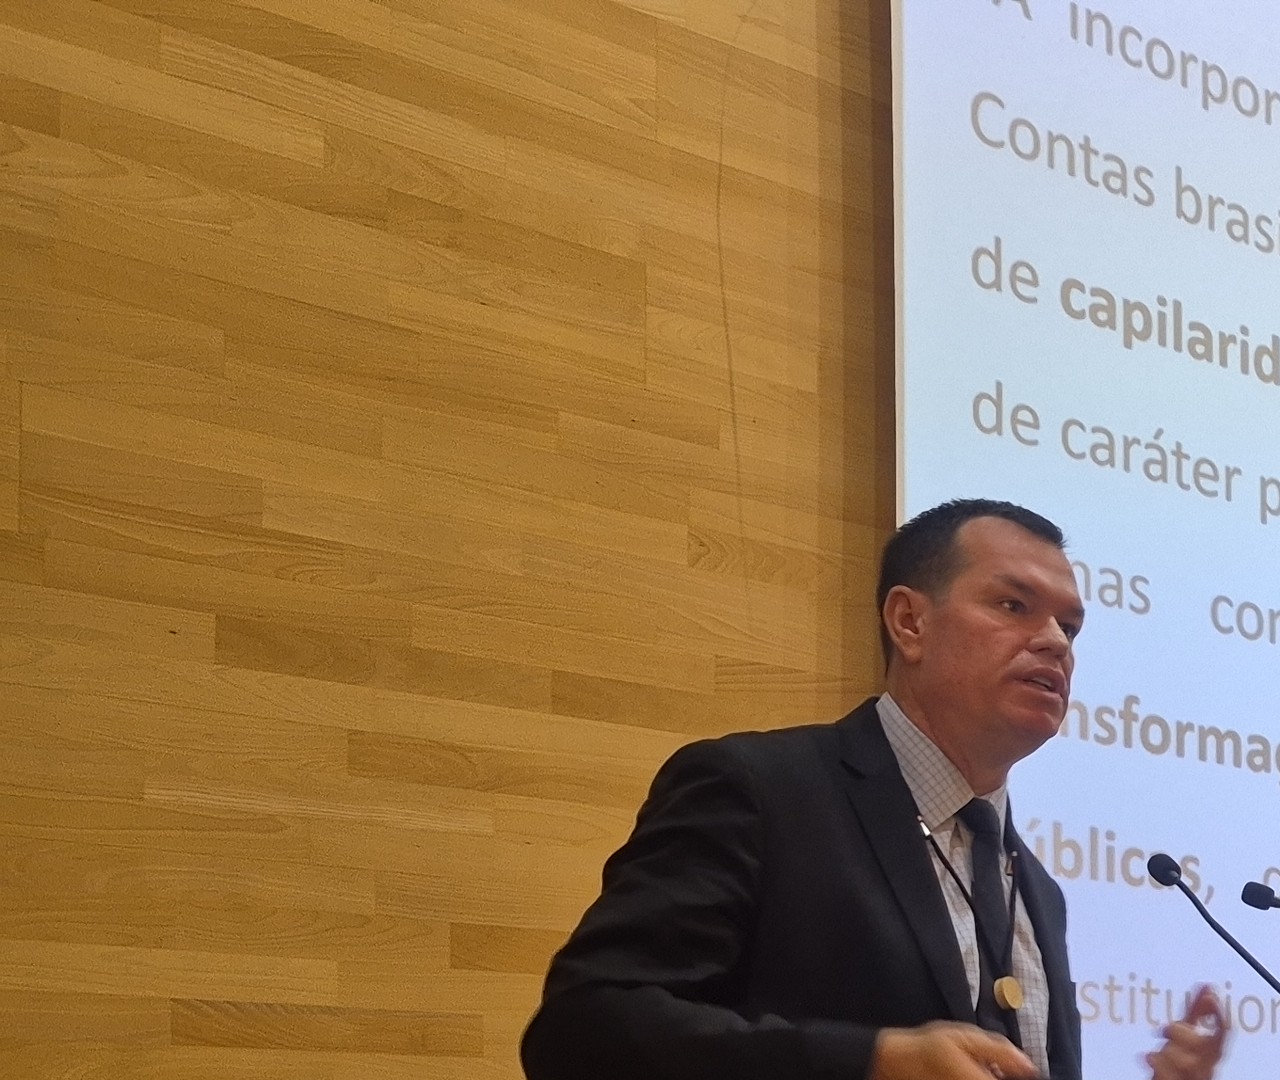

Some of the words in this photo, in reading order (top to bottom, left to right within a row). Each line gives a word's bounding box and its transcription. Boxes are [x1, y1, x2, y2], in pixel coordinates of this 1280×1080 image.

[971, 92, 1155, 207] Contas
[972, 236, 1039, 304] de
[973, 380, 1040, 446] de
[1061, 419, 1242, 502] caráter
